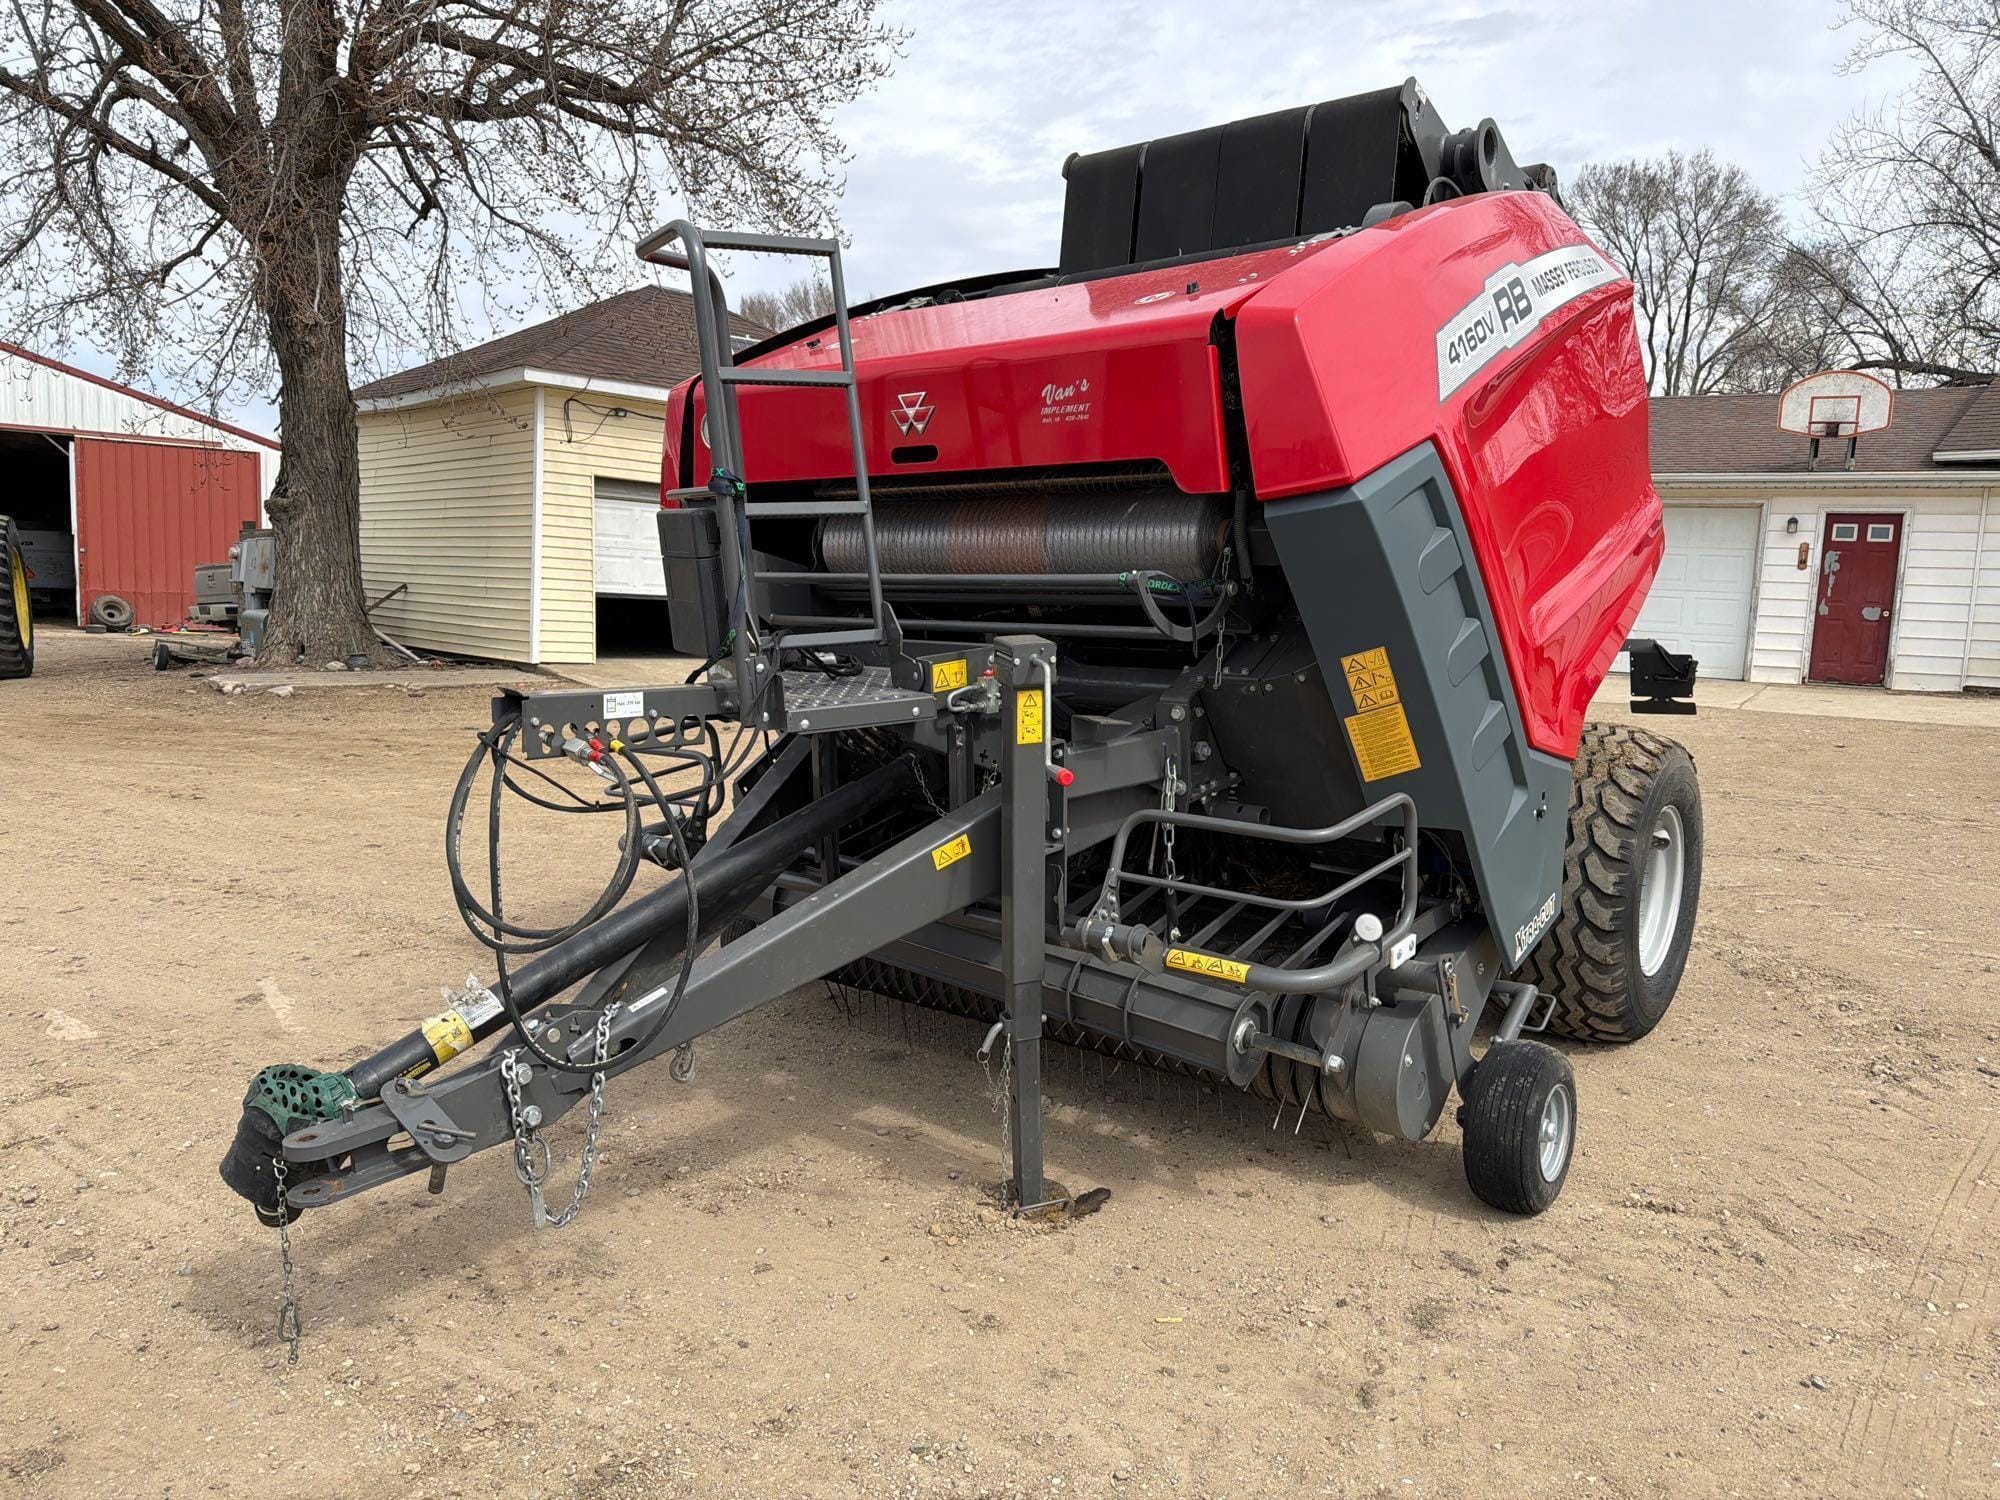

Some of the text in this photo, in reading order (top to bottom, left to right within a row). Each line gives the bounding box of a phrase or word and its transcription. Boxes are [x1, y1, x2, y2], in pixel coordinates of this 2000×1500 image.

[1448, 257, 1604, 364] 4160V RB MASSEY FERGUSON
[1041, 378, 1090, 405] Van's
[1041, 403, 1090, 415] IMPLEMENT
